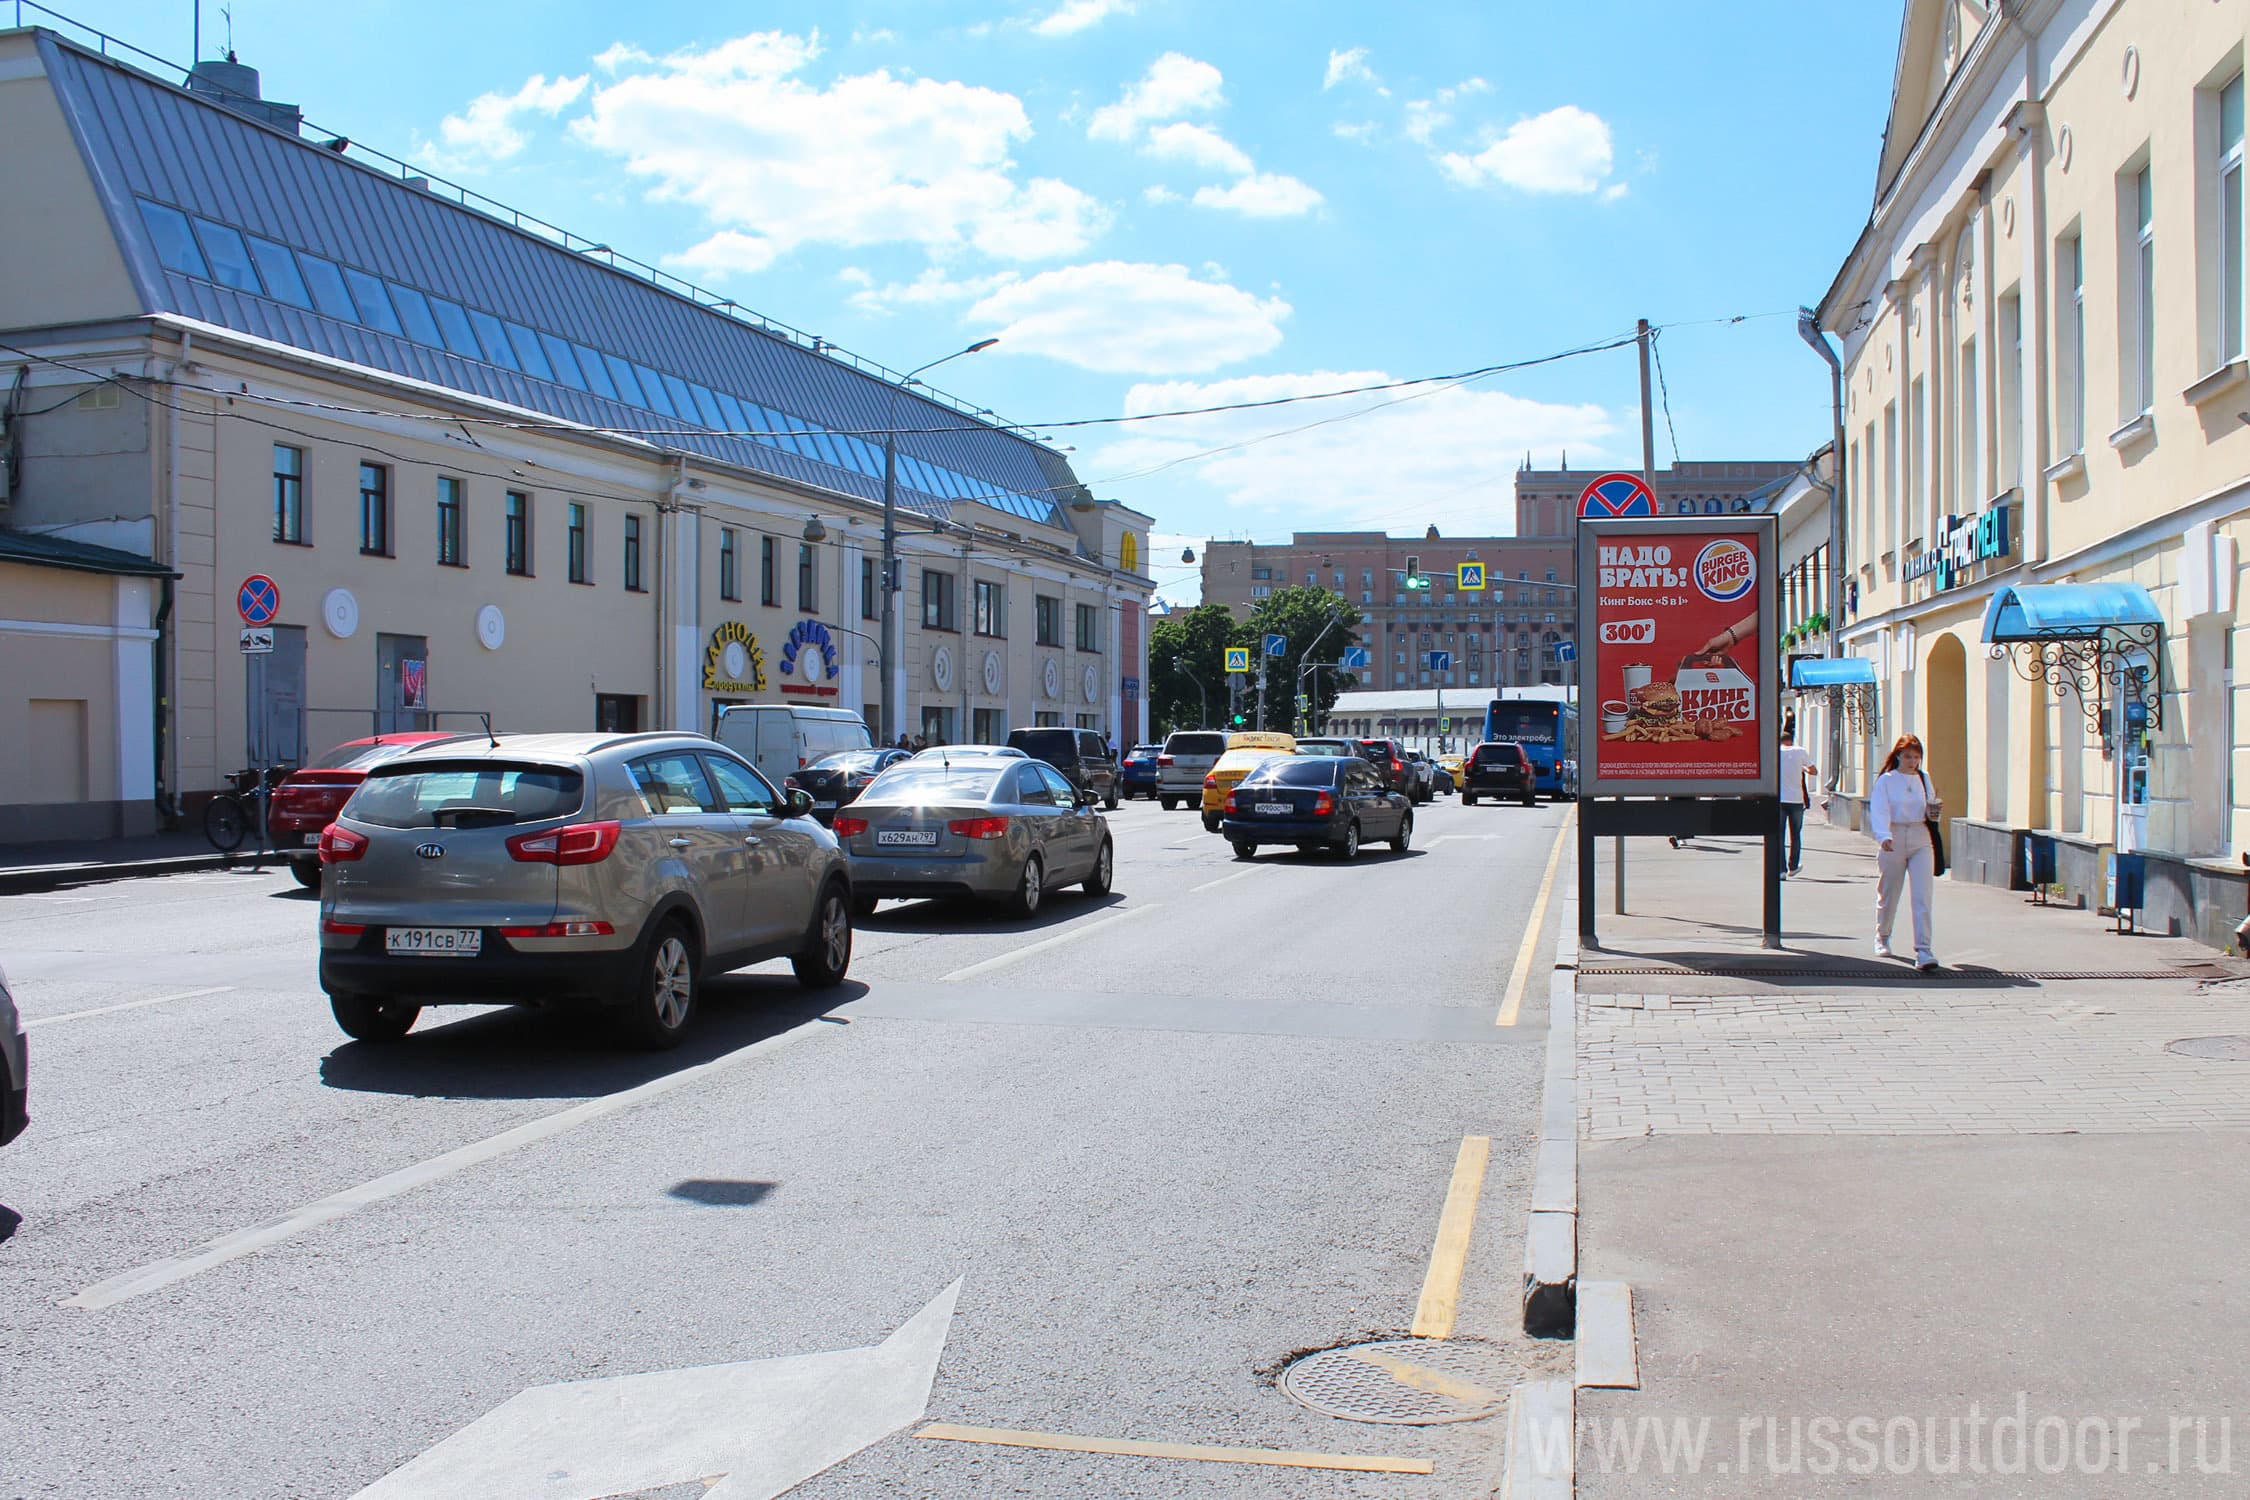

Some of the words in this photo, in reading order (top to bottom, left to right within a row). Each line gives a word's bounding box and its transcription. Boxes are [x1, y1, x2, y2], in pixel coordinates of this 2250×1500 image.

[1950, 507, 1999, 571] ТРАСТМЕД
[1600, 546, 1671, 567] НАДО
[1702, 551, 1747, 574] BURGER
[1600, 568, 1687, 588] БРАТЬ!
[1704, 561, 1749, 589] KING
[1600, 597, 1625, 606] Кинг
[1628, 596, 1653, 606] Бокс
[704, 621, 767, 690] МАГНОЛИЯ
[1681, 688, 1749, 711] КИНГ
[1681, 700, 1750, 722] БОКС
[1493, 733, 1507, 741] Это
[1509, 734, 1555, 744] электробус.
[420, 846, 441, 856] KIA
